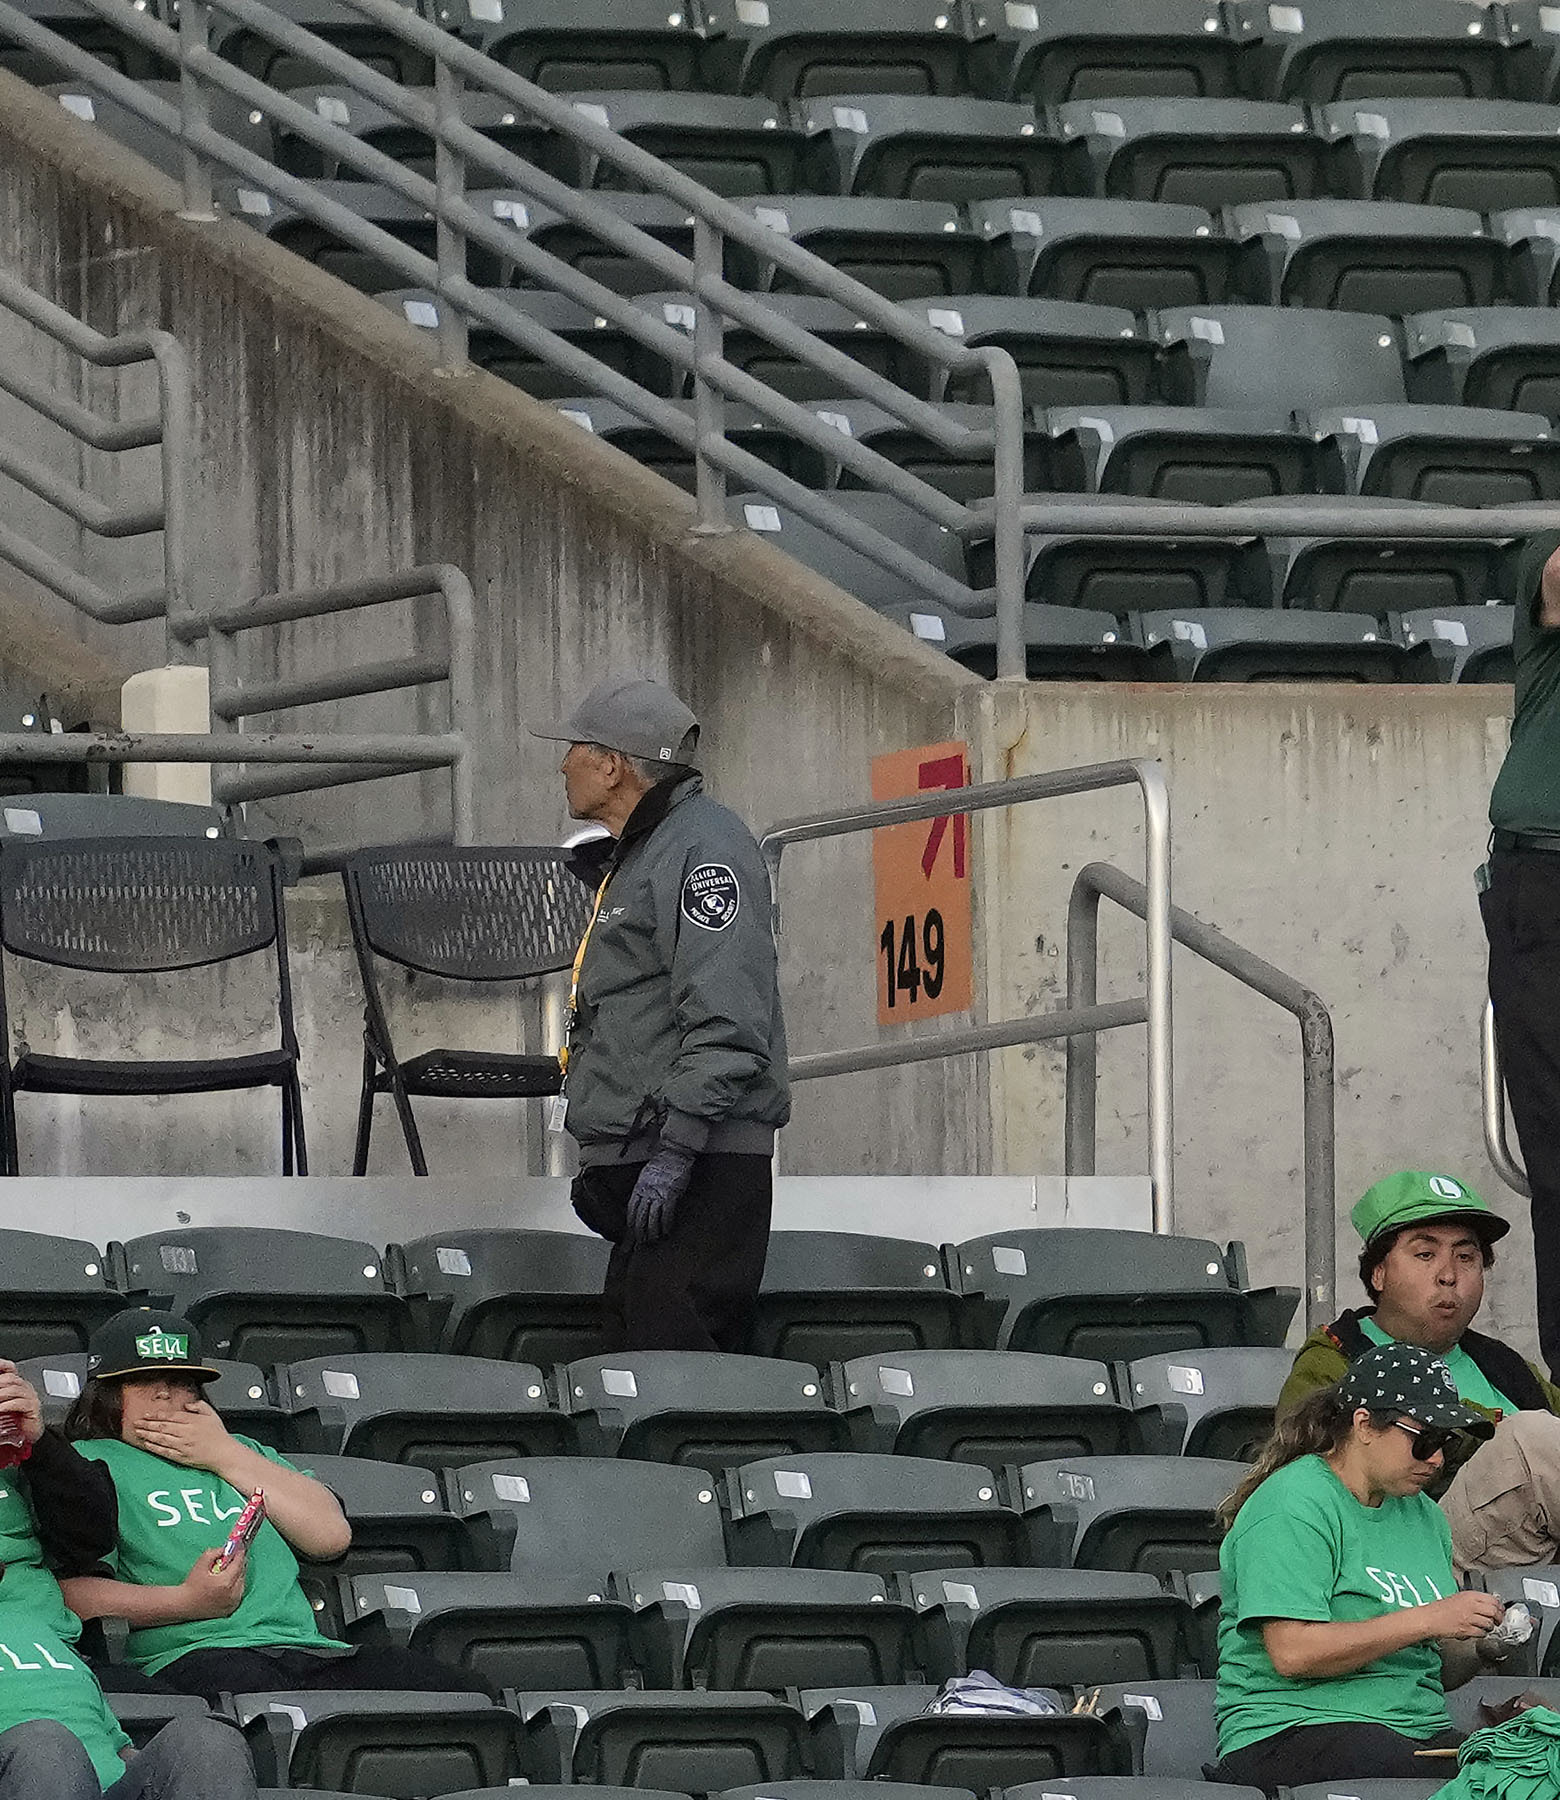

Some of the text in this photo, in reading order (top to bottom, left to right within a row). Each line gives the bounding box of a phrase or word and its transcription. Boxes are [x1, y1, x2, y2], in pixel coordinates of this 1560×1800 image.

[690, 868, 717, 882] ALLIED
[690, 876, 733, 892] UNIVERSAL
[881, 907, 944, 1008] 149
[1434, 1177, 1457, 1198] L
[138, 1338, 185, 1358] SELL
[147, 1488, 248, 1527] SEL
[0, 1642, 74, 1671] LL
